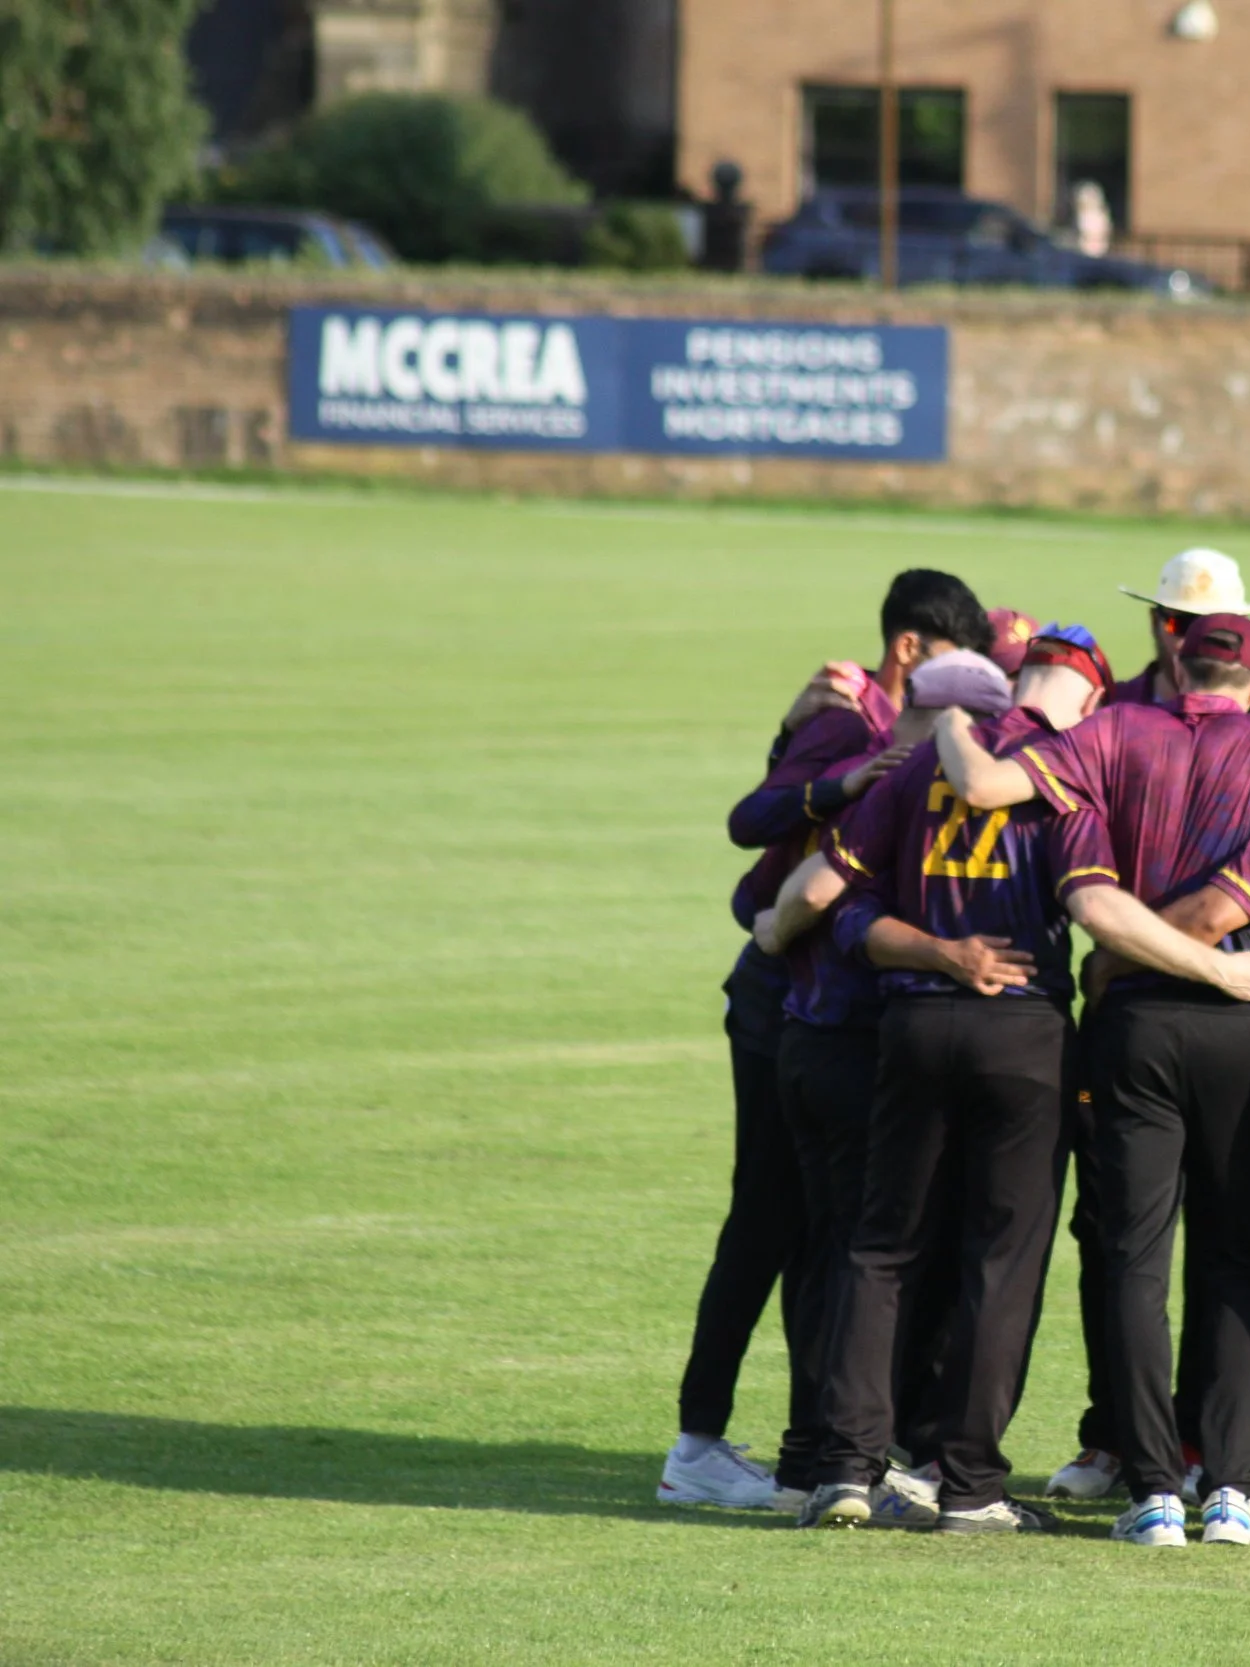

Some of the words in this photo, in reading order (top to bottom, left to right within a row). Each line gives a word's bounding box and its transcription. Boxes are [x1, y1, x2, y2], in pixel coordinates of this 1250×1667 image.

[320, 315, 587, 405] MCCREA
[686, 327, 882, 371] PENSIONS
[651, 365, 917, 409] INVESTMENTS
[664, 403, 903, 446] MORTGAGES
